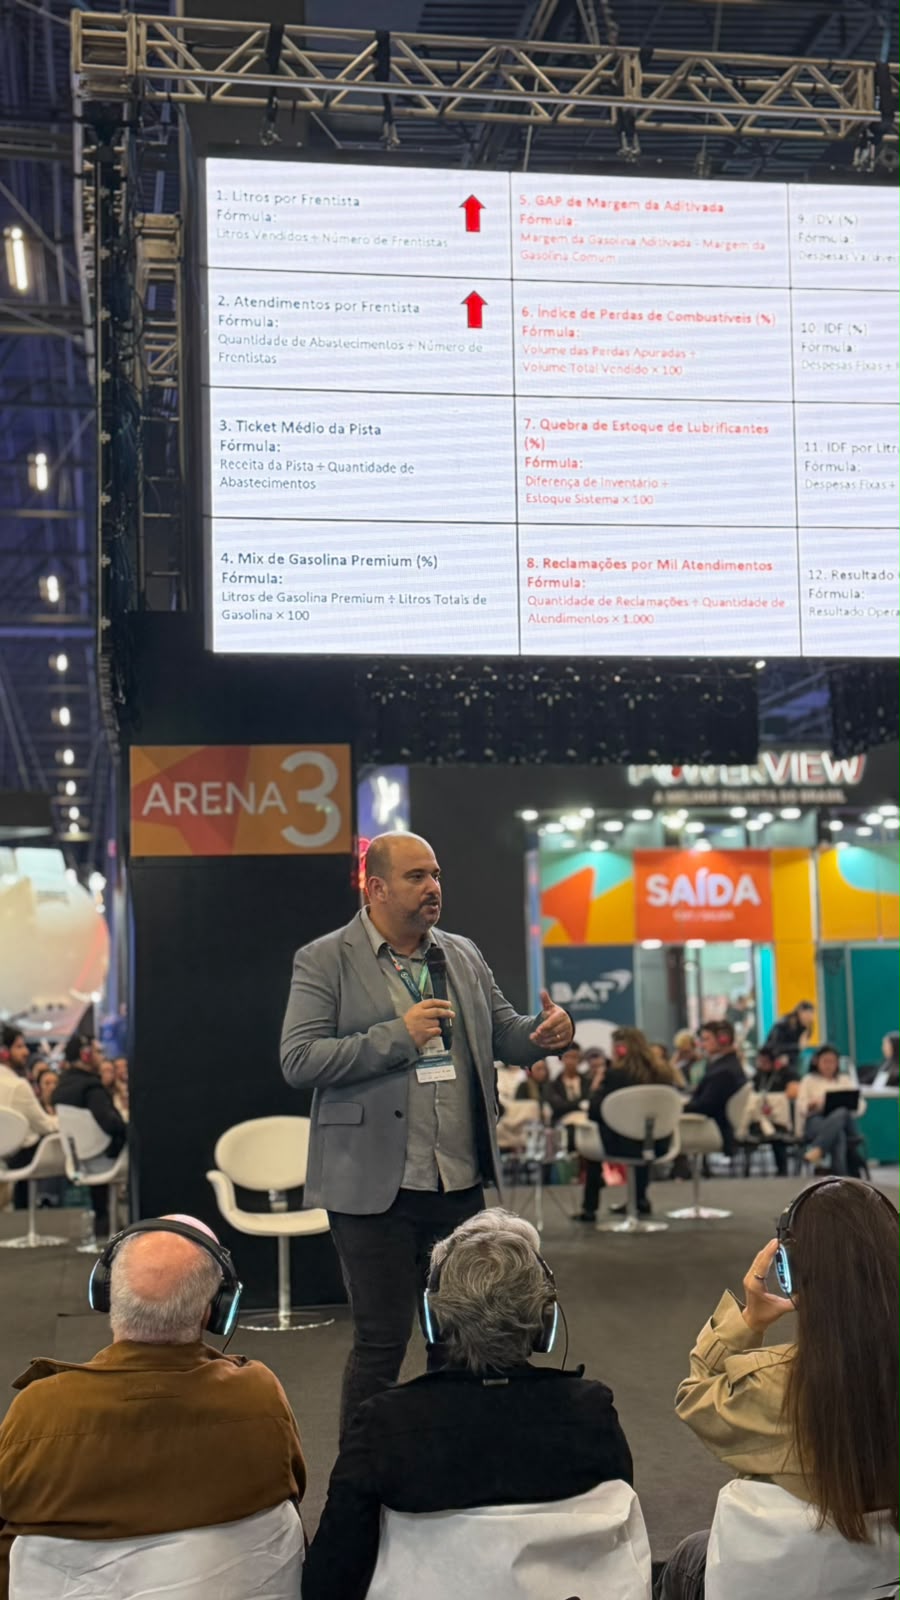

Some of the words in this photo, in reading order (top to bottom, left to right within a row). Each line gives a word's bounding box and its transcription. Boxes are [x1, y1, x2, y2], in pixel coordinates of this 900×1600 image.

[216, 190, 228, 202] 1.
[232, 191, 270, 203] Litros
[275, 194, 296, 206] por
[301, 194, 360, 207] Frentista
[519, 196, 529, 205] 5.
[536, 197, 562, 207] GAP
[567, 198, 582, 207] de
[587, 198, 639, 212] Margem
[645, 199, 659, 210] da
[664, 201, 724, 213] Aditivada
[216, 209, 276, 223] Fórmula:
[520, 214, 577, 226] Fórmula:
[216, 230, 249, 240] Litros
[254, 230, 308, 242] Vendidos
[322, 234, 370, 244] Número
[374, 236, 388, 245] de
[392, 236, 448, 248] Frentistas
[520, 233, 568, 245] Margem
[572, 235, 584, 244] da
[588, 235, 636, 246] Gasolina
[640, 237, 691, 248] Aditivada
[703, 239, 748, 251] Margem
[752, 242, 765, 251] da
[520, 250, 568, 262] Gasolina
[572, 252, 616, 262] Comum
[218, 296, 230, 308] 2.
[234, 296, 330, 311] Atendimentos
[335, 300, 357, 312] por
[362, 300, 420, 314] Frentista
[218, 315, 279, 328] Fórmula:
[522, 307, 534, 317] 6.
[538, 305, 576, 319] Índice
[581, 309, 595, 319] de
[600, 310, 643, 321] Perdas
[648, 310, 663, 321] de
[756, 313, 776, 326] (%)
[522, 326, 581, 338] Fórmula:
[824, 323, 843, 334] IDF
[848, 323, 867, 336] (%)
[218, 334, 288, 347] Quantidade
[292, 336, 306, 347] de
[310, 338, 404, 351] Abastecimentos
[418, 341, 464, 352] Número
[468, 342, 483, 353] de
[218, 352, 276, 364] Frentistas
[523, 344, 566, 356] Volume
[570, 346, 588, 356] das
[592, 346, 630, 357] Perdas
[634, 348, 686, 360] Apuradas
[523, 362, 566, 373] Volume
[571, 362, 598, 374] Total
[603, 363, 648, 375] Vendido
[663, 365, 682, 375] 100
[220, 420, 232, 432] 3.
[236, 420, 276, 433] Ticket
[282, 420, 324, 434] Médio
[329, 422, 345, 434] da
[350, 424, 382, 436] Pista
[524, 419, 535, 429] 7.
[540, 419, 588, 432] Quebra
[593, 420, 608, 431] de
[612, 421, 663, 434] Estoque
[668, 422, 682, 432] de
[688, 422, 769, 434] Lubrificantes
[220, 440, 280, 452] Fórmula:
[524, 438, 546, 451] (%)
[805, 443, 823, 452] 11.
[827, 443, 848, 453] IDF
[852, 444, 873, 455] por
[220, 460, 264, 470] Receita
[268, 460, 282, 470] da
[286, 460, 314, 472] Pista
[328, 462, 396, 474] Quantidade
[400, 463, 414, 474] de
[525, 456, 583, 469] Fórmula:
[805, 460, 861, 473] Fórmula:
[220, 477, 316, 490] Abastecimentos
[525, 476, 580, 489] Diferença
[584, 477, 597, 488] de
[601, 477, 658, 489] Inventário
[805, 479, 856, 492] Despesas
[526, 494, 571, 507] Estoque
[575, 495, 619, 505] Sistema
[634, 495, 653, 505] 100
[220, 553, 234, 565] 4.
[238, 553, 264, 565] Mix
[268, 554, 284, 565] de
[289, 554, 347, 566] Gasolina
[352, 555, 412, 567] Premium
[416, 555, 438, 568] (%)
[526, 558, 539, 569] 8.
[543, 558, 627, 572] Reclamações
[632, 561, 652, 572] por
[657, 560, 678, 571] Mil
[682, 560, 772, 571] Atendimentos
[222, 572, 282, 584] Fórmula:
[809, 570, 827, 580] 12.
[832, 571, 894, 581] Resultado
[527, 576, 586, 589] Fórmula:
[222, 592, 254, 603] Litros
[258, 592, 272, 603] de
[276, 592, 327, 604] Gasolina
[331, 593, 384, 604] Premium
[399, 594, 430, 605] Litros
[436, 594, 469, 606] Totais
[472, 594, 486, 606] de
[809, 588, 865, 599] Fórmula:
[528, 596, 594, 608] Quantidade
[599, 596, 612, 607] de
[616, 597, 688, 610] Reclamações
[703, 597, 767, 609] Quantidade
[771, 598, 785, 608] de
[222, 610, 272, 621] Gasolina
[288, 610, 310, 621] 100
[809, 606, 864, 617] Resultado
[528, 614, 608, 625] Atendimentos
[624, 615, 654, 625] 1.000
[142, 782, 288, 816] ARENA
[281, 750, 341, 848] 3
[646, 867, 761, 908] SAÍDA
